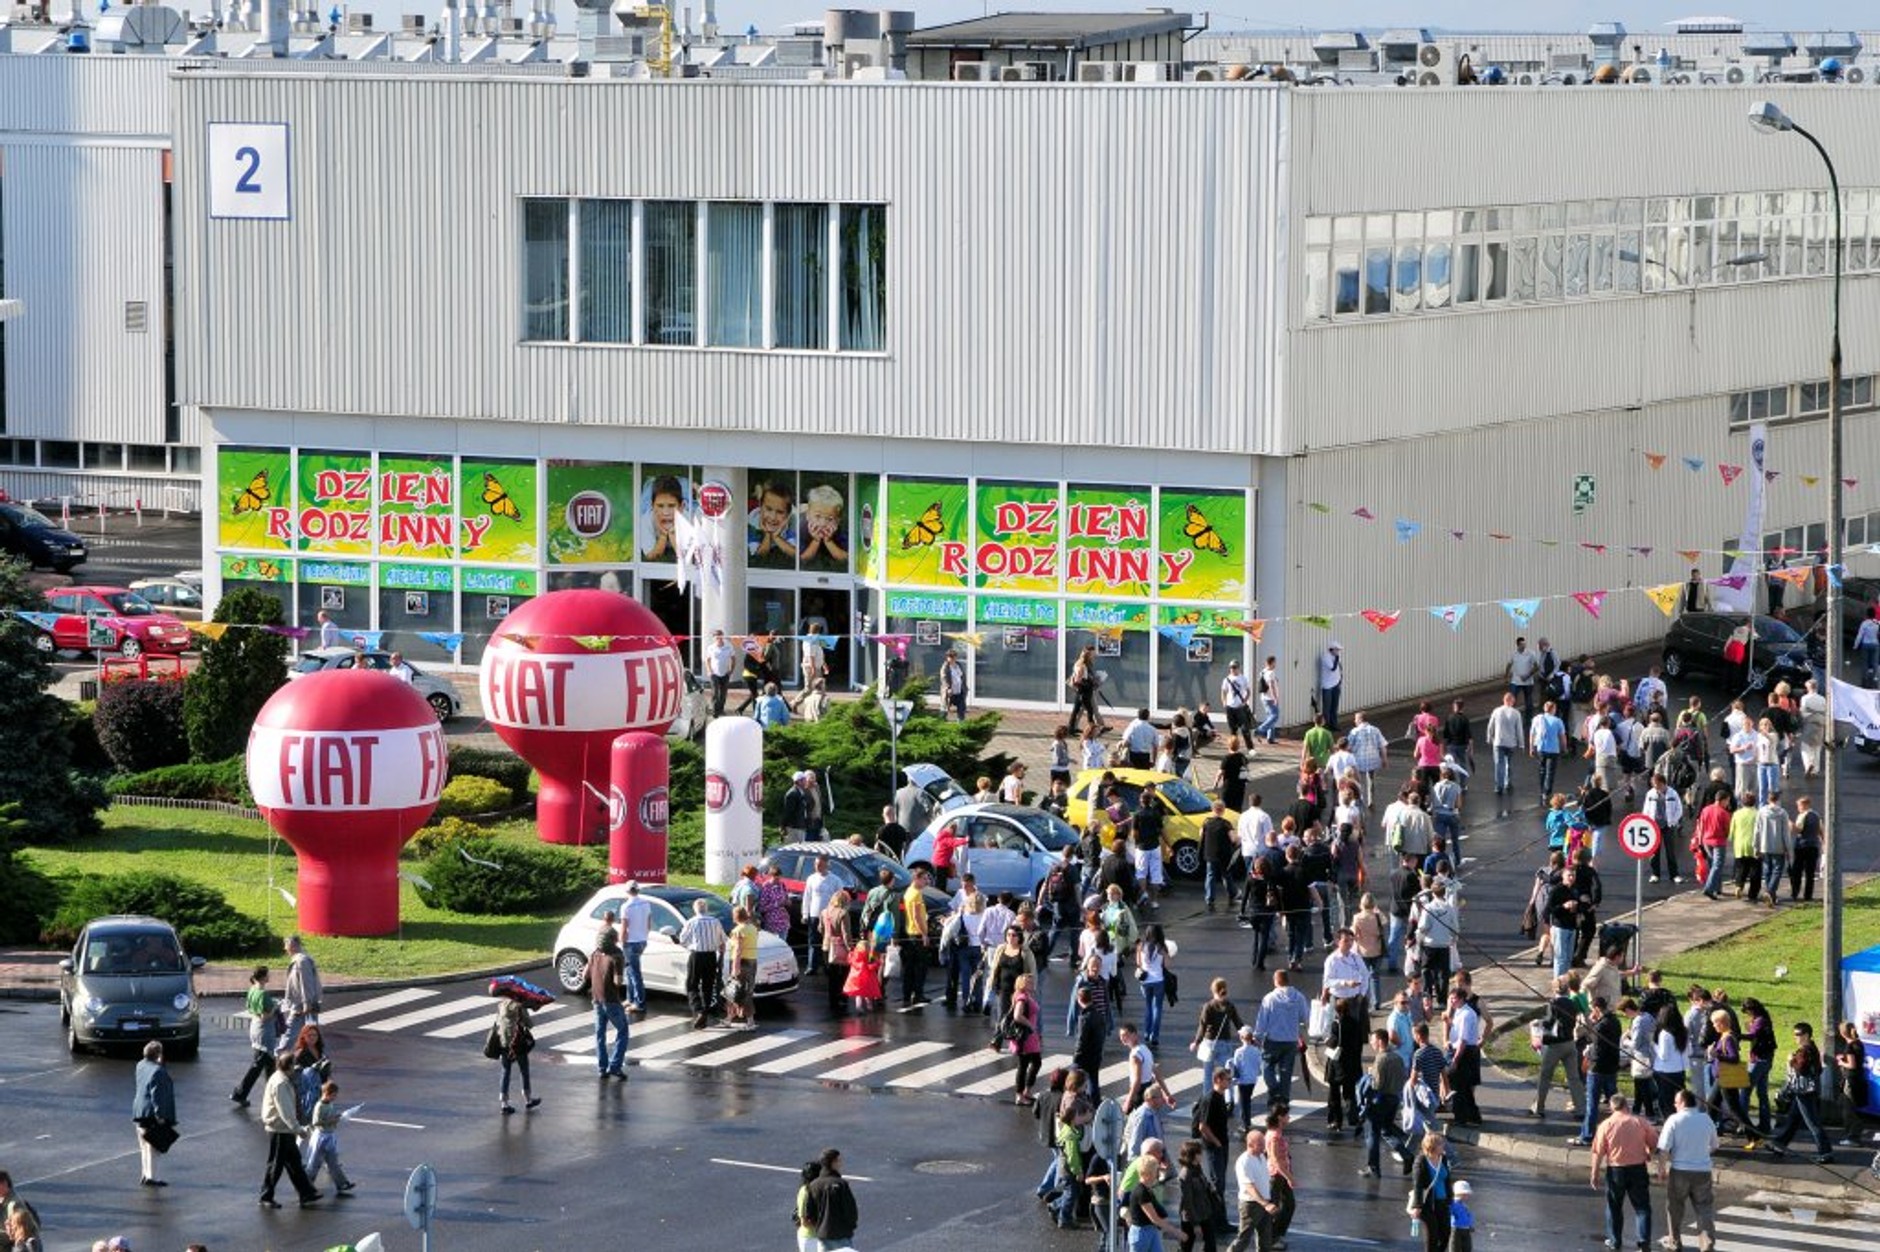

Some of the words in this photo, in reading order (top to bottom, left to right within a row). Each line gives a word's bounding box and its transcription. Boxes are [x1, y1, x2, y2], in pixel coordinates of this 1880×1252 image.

[235, 146, 262, 193] 2
[268, 508, 493, 548] RODZINNY
[576, 504, 604, 526] FIAT
[942, 542, 1194, 585] RODZINNY
[489, 656, 574, 726] FIAT
[624, 652, 684, 724] FIA
[279, 736, 379, 805] FIAT
[1628, 826, 1650, 847] 15
